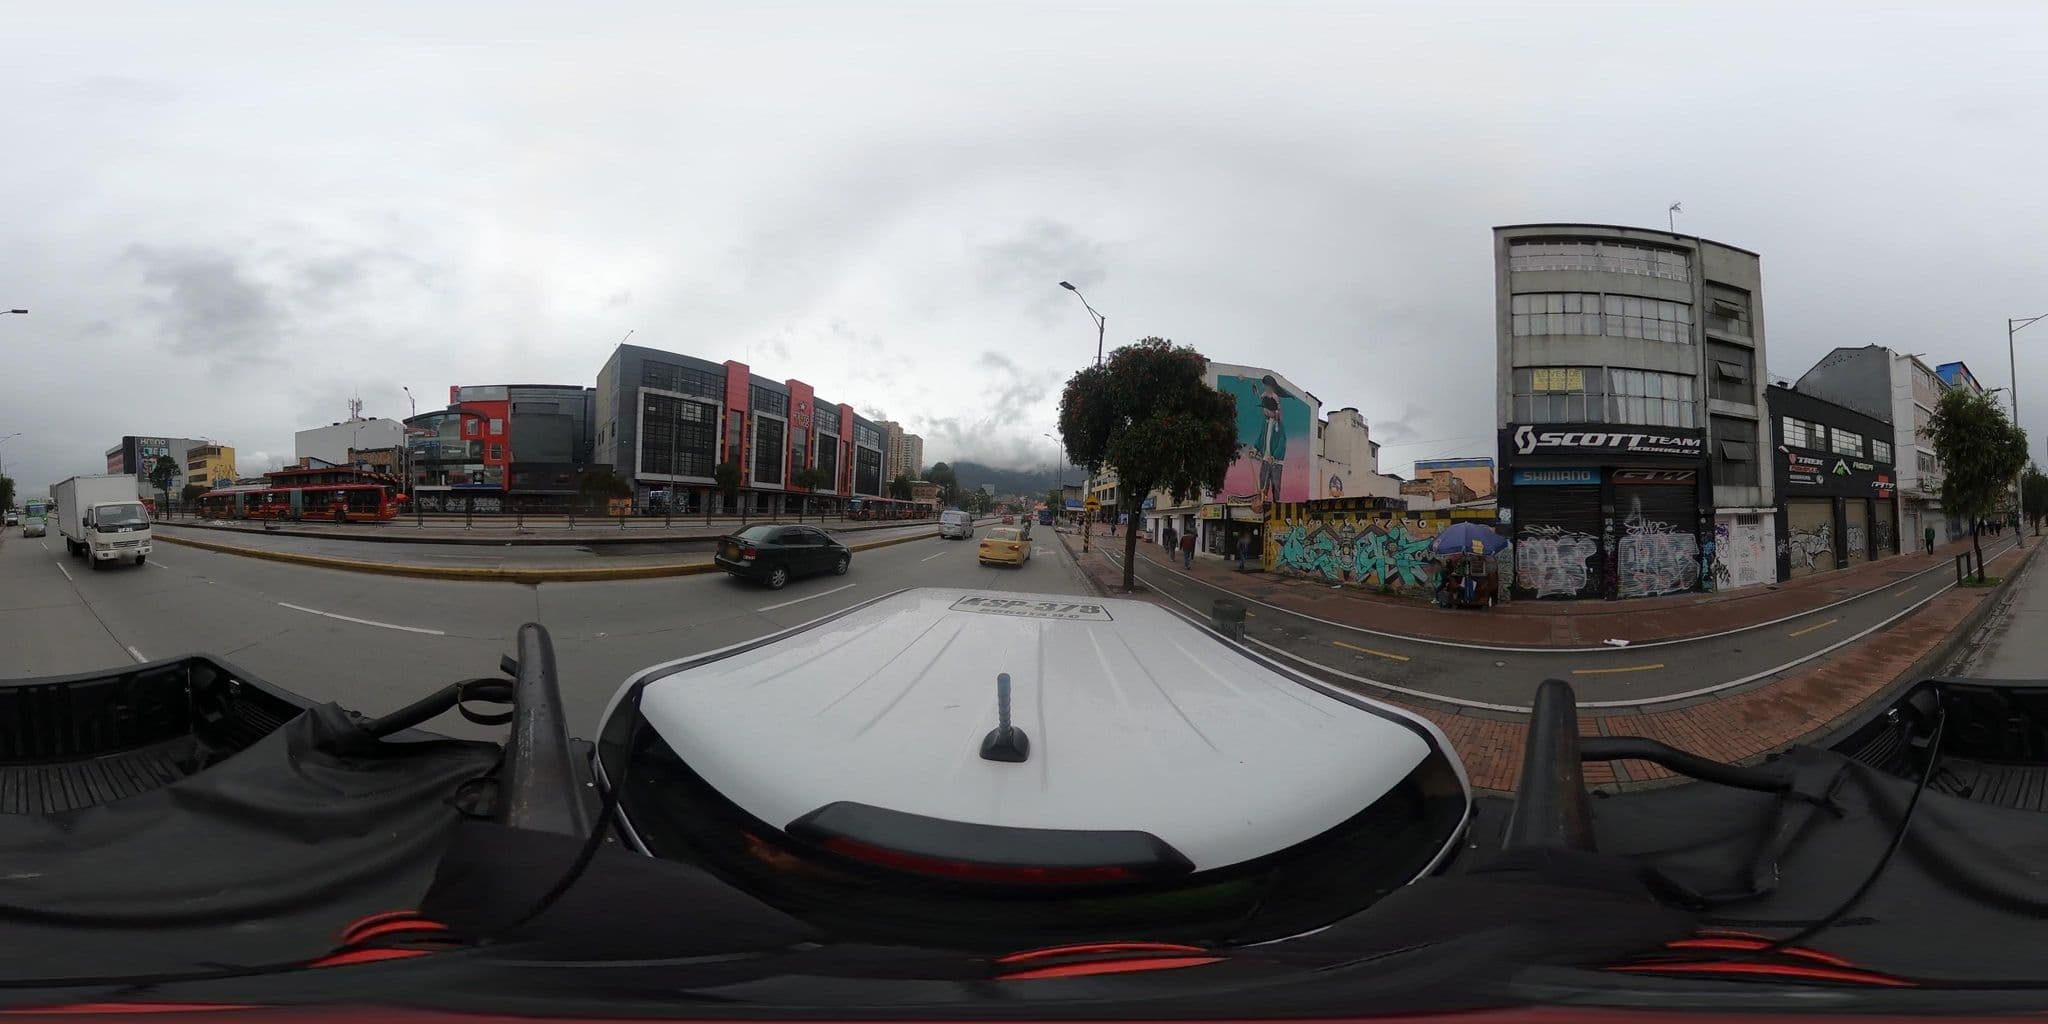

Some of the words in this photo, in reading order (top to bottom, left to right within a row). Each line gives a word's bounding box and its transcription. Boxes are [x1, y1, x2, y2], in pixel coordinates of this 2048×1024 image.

[1536, 433, 1647, 447] SCOTT
[1648, 435, 1700, 447] TEAM
[1627, 446, 1701, 455] RODRIGUEZ
[1797, 456, 1824, 466] TREK
[1522, 470, 1591, 481] SHIMANO
